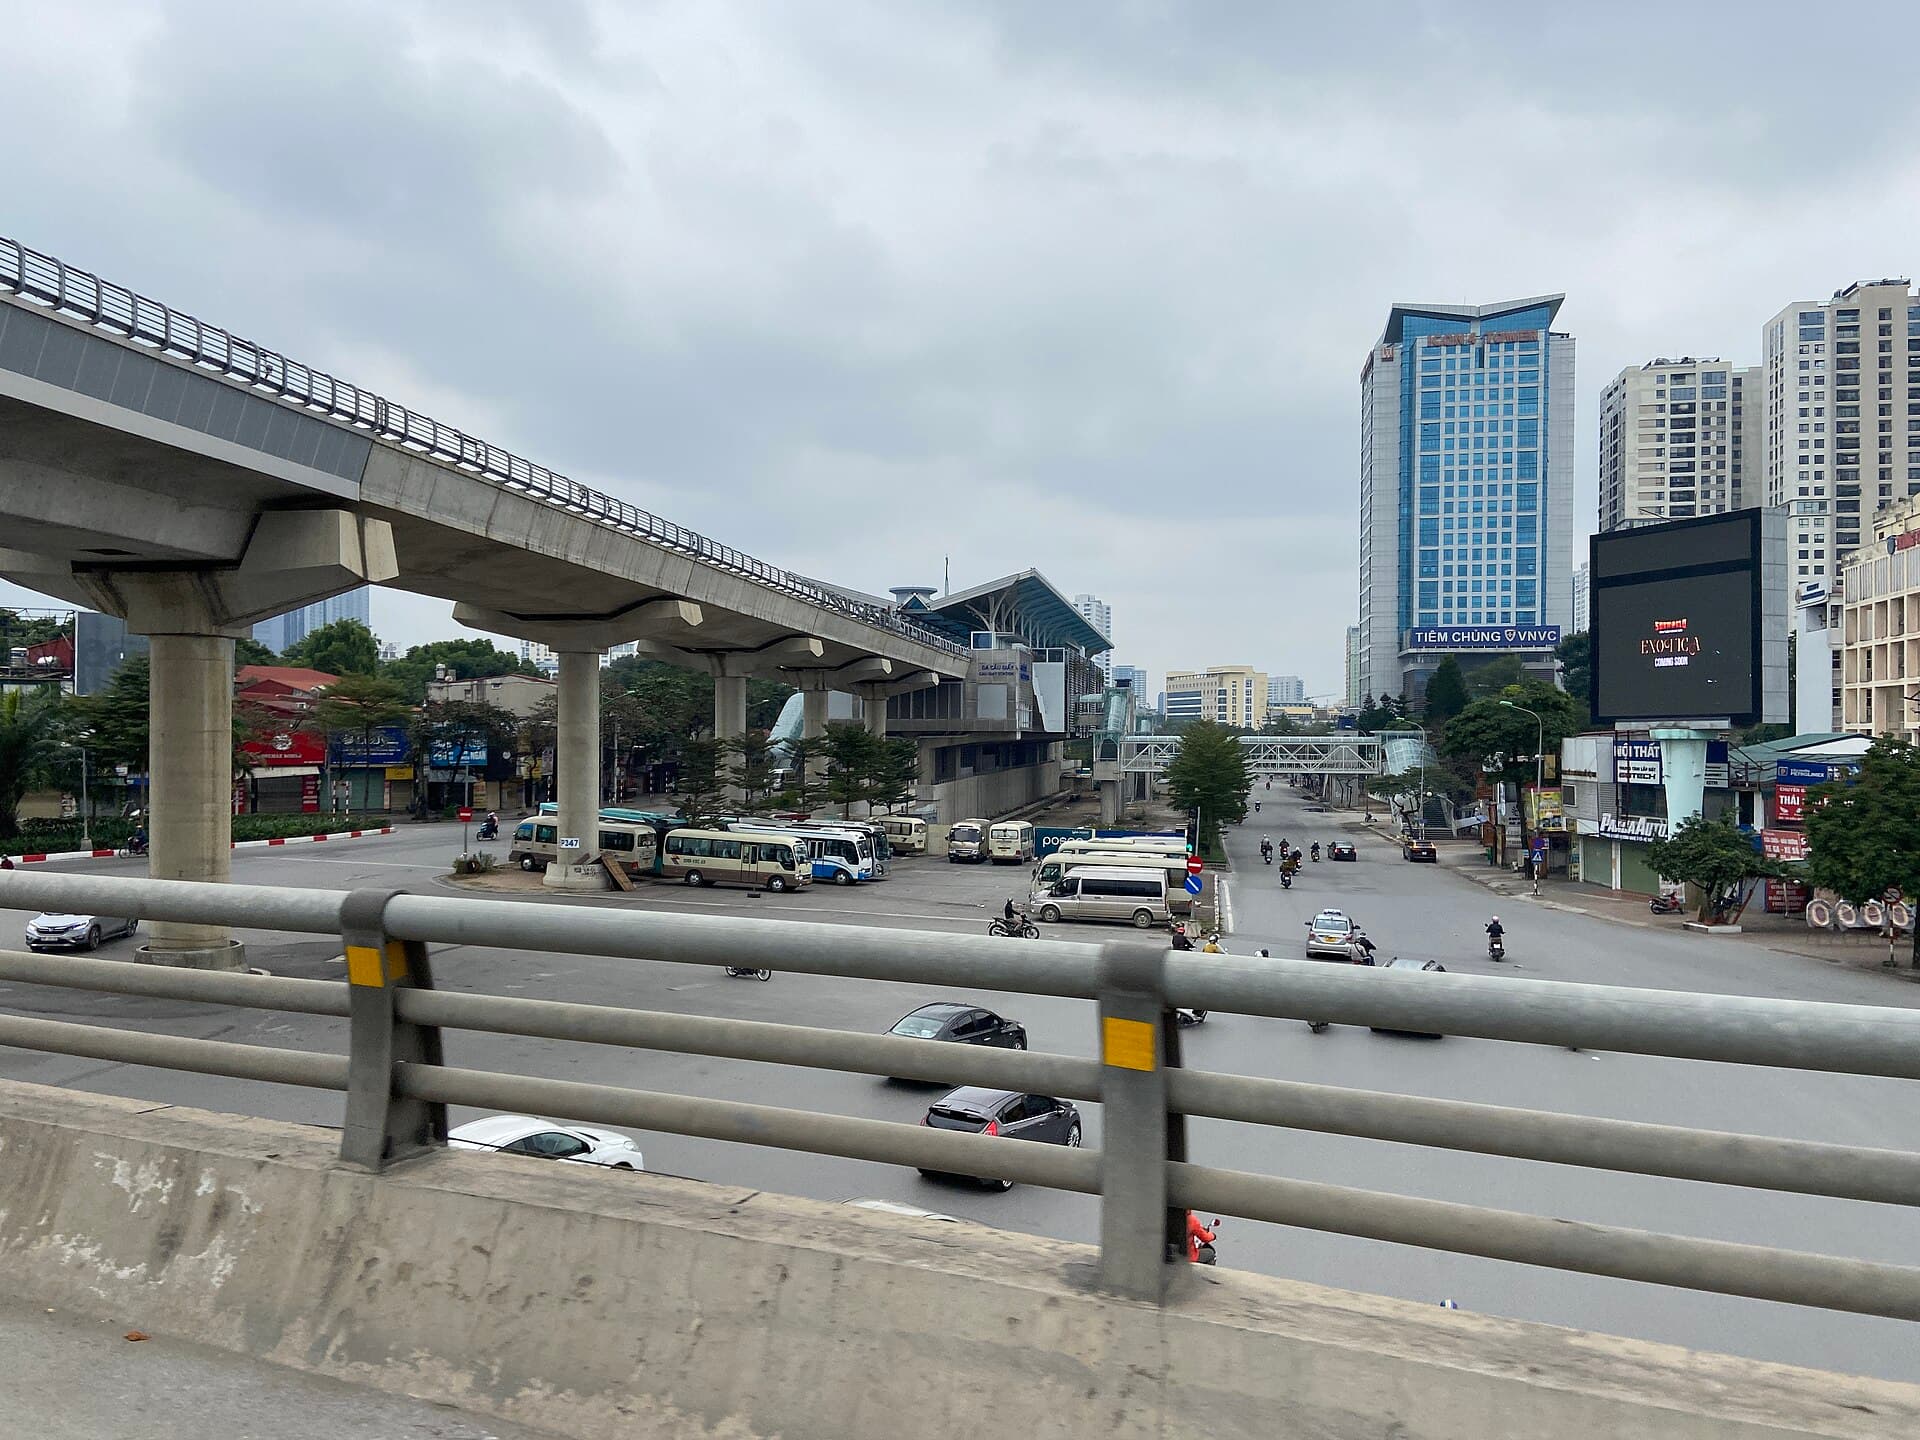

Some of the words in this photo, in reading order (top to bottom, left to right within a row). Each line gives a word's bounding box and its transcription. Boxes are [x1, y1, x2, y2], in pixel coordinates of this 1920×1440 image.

[1415, 630, 1448, 642] TIÊM
[1518, 630, 1557, 642] VNVC
[1674, 656, 1688, 666] SOON
[1633, 742, 1660, 758] THẤT
[1779, 794, 1800, 806] THÁI
